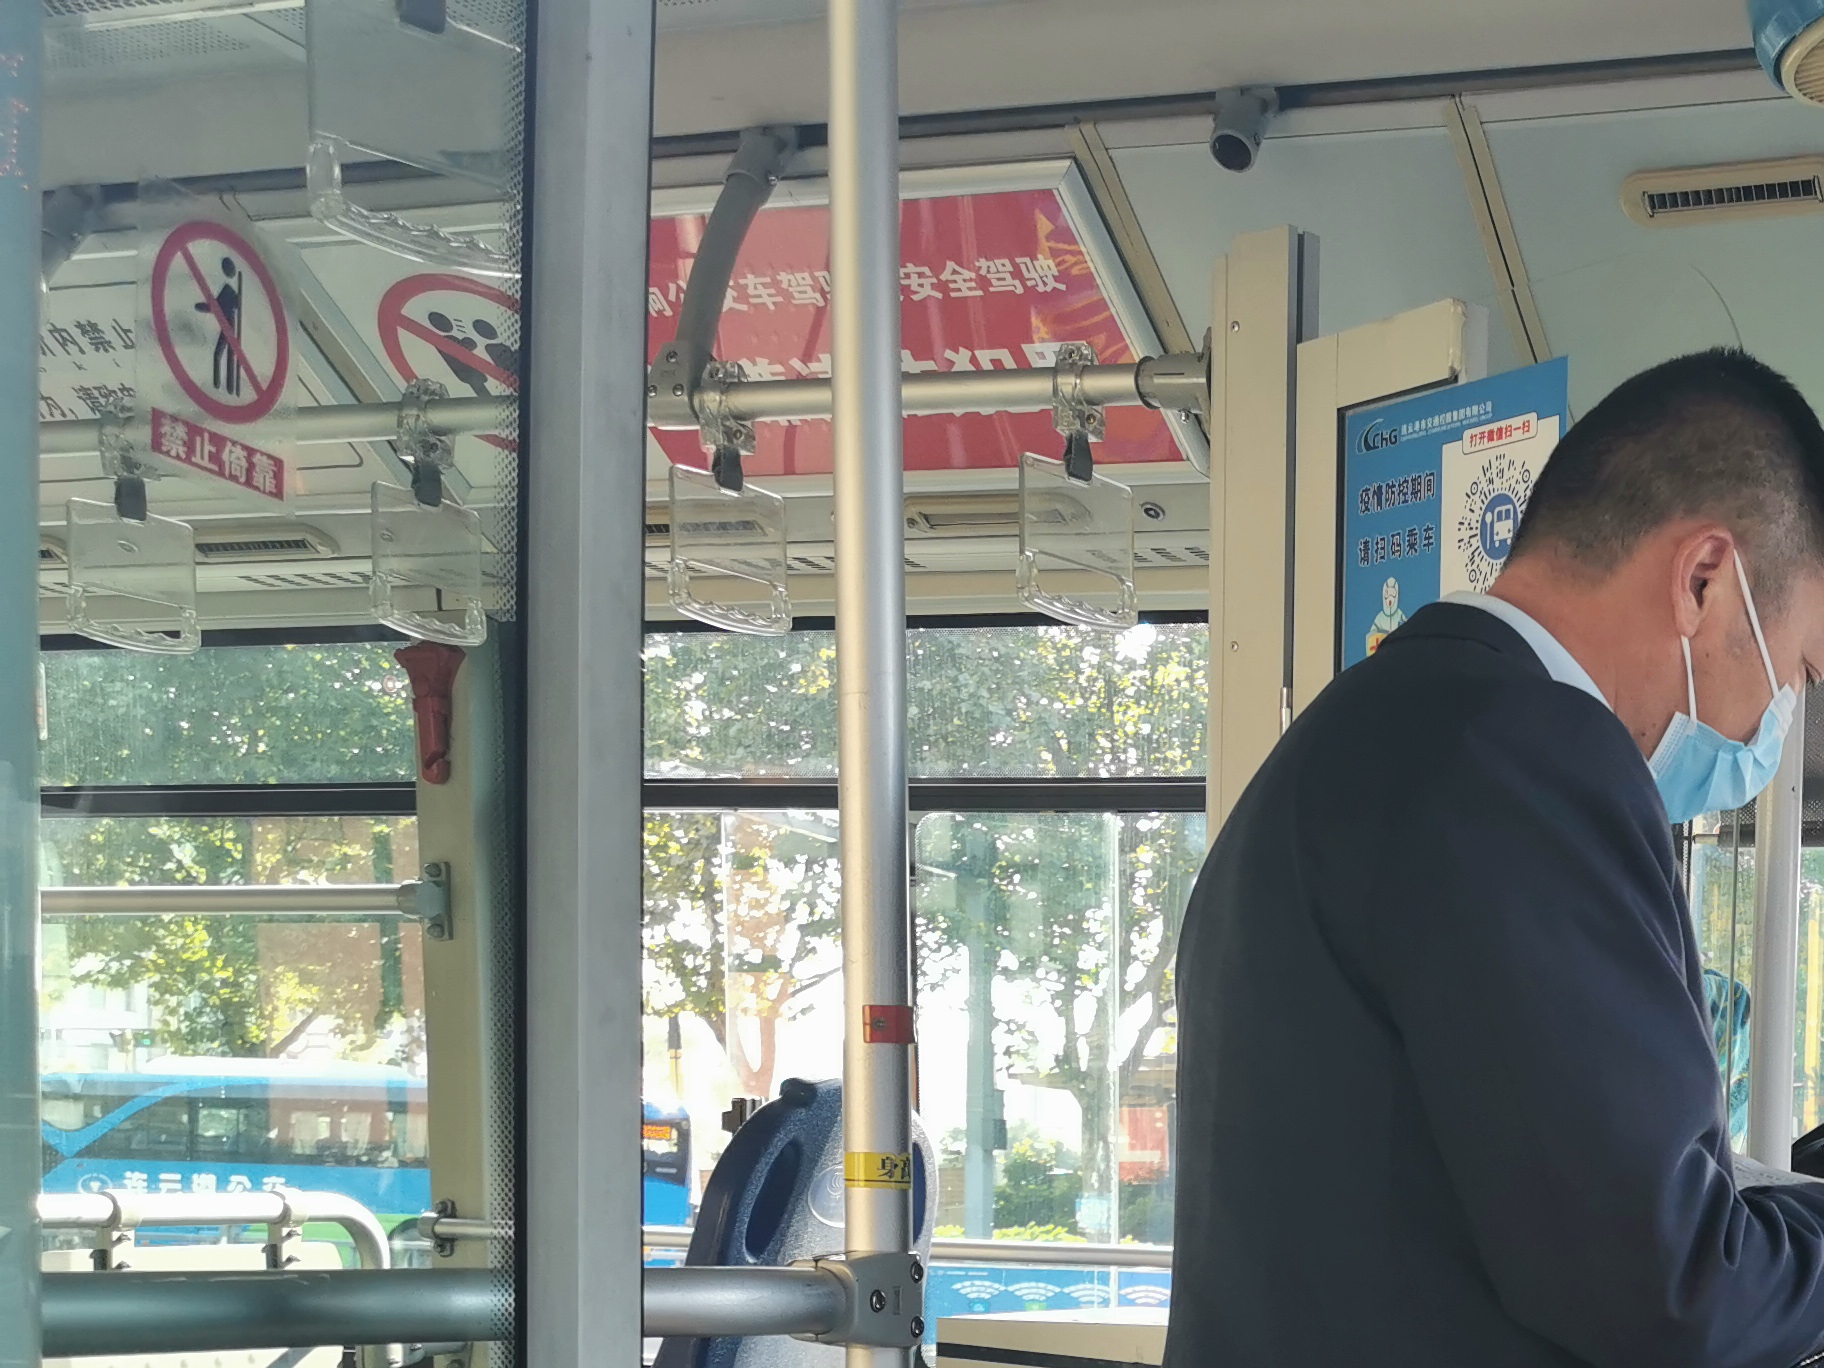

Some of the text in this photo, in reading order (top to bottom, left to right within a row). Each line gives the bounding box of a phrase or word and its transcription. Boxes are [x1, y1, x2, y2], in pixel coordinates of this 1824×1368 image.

[159, 416, 278, 494] 禁止倚靠
[1469, 419, 1531, 448] 打开微信扫一扫
[1359, 471, 1435, 515] 疫情防控期间
[1358, 523, 1435, 567] 请扫码乘车
